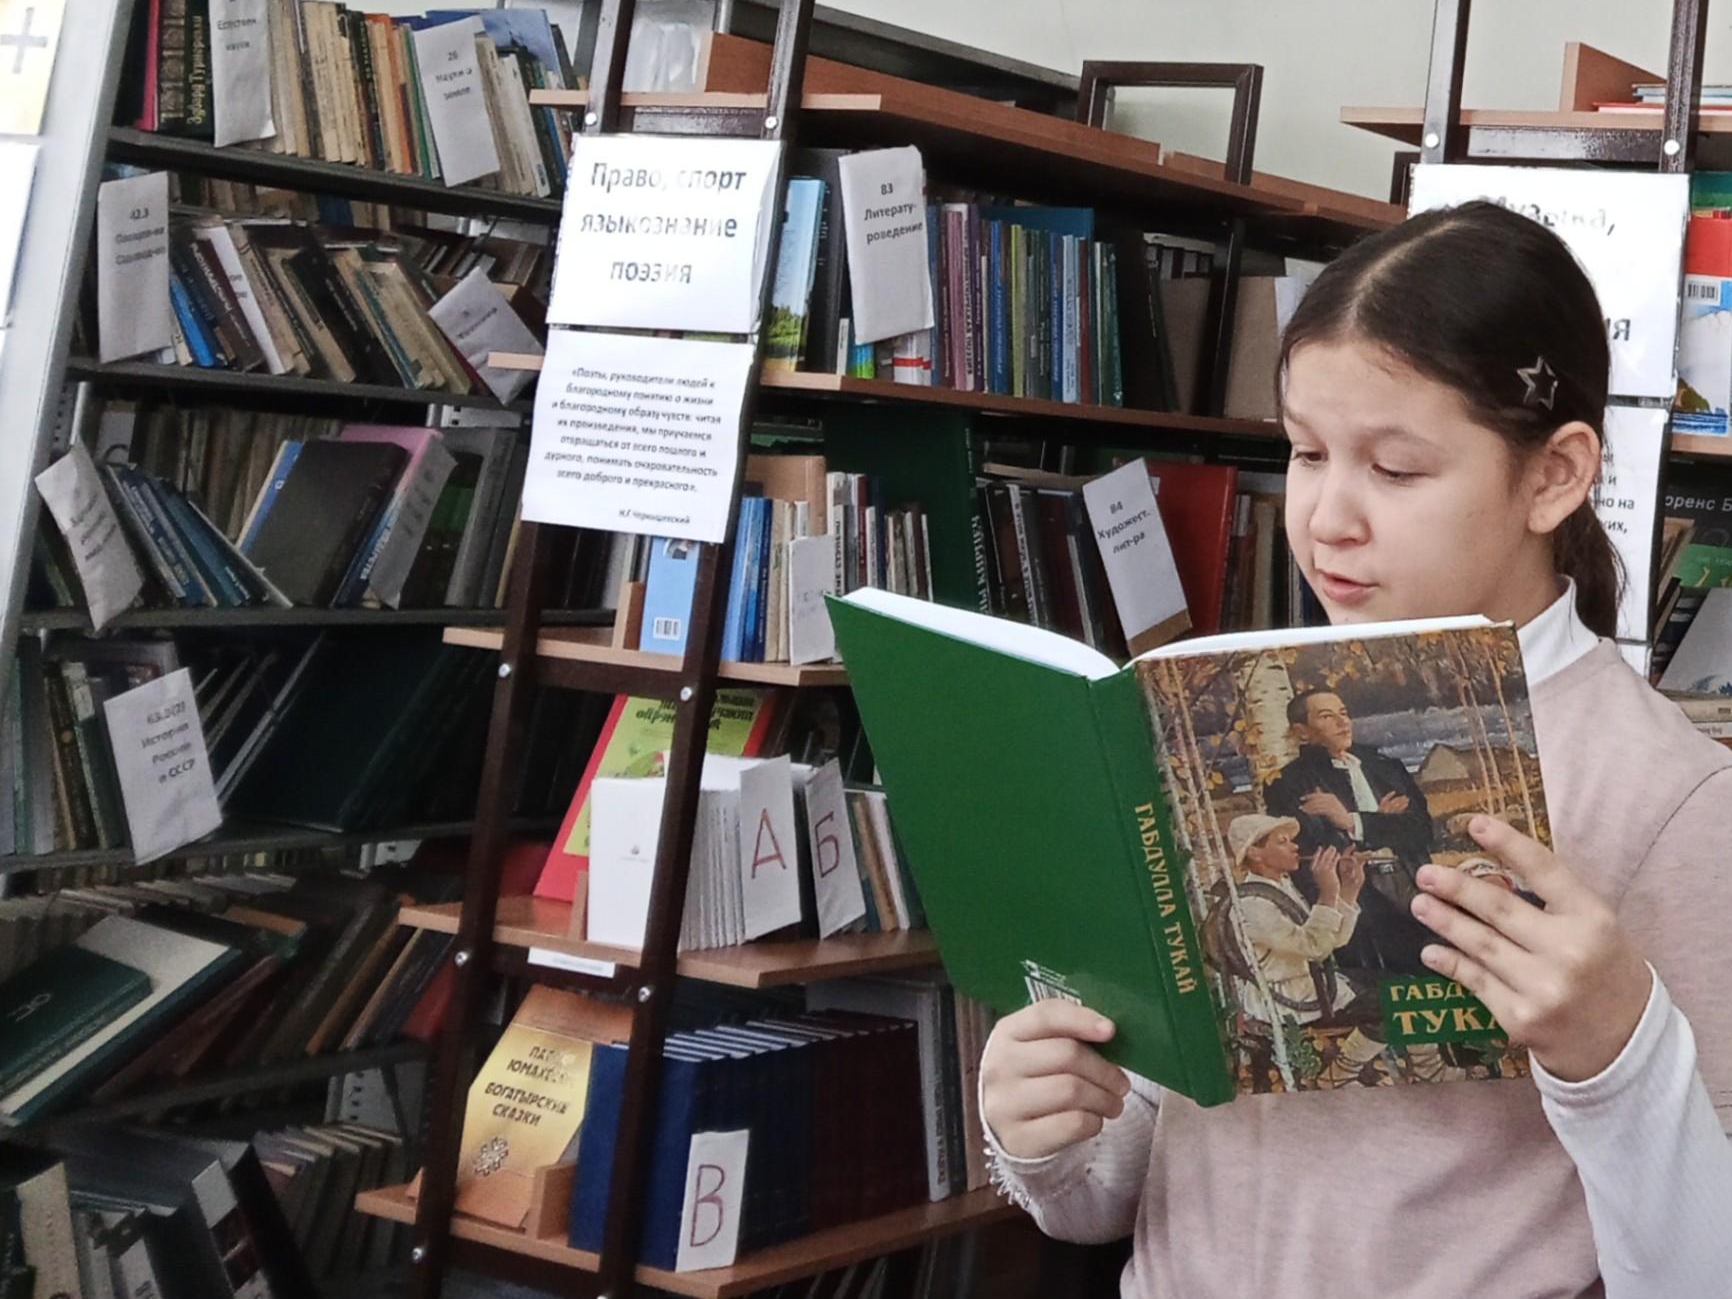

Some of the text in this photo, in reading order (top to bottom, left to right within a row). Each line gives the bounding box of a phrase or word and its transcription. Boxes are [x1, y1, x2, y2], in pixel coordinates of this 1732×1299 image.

[880, 182, 894, 196] 83
[580, 211, 738, 239] языкознание
[609, 260, 693, 285] поэзия
[1664, 494, 1716, 511] оренс
[750, 807, 788, 879] А
[815, 811, 841, 880] Б
[1134, 802, 1198, 995] ГАБДУЛЛА ТУКАЙ
[1389, 982, 1466, 1002] ГАБД
[1391, 1006, 1498, 1036] ТУК
[491, 1102, 543, 1128] СКАЗКИ
